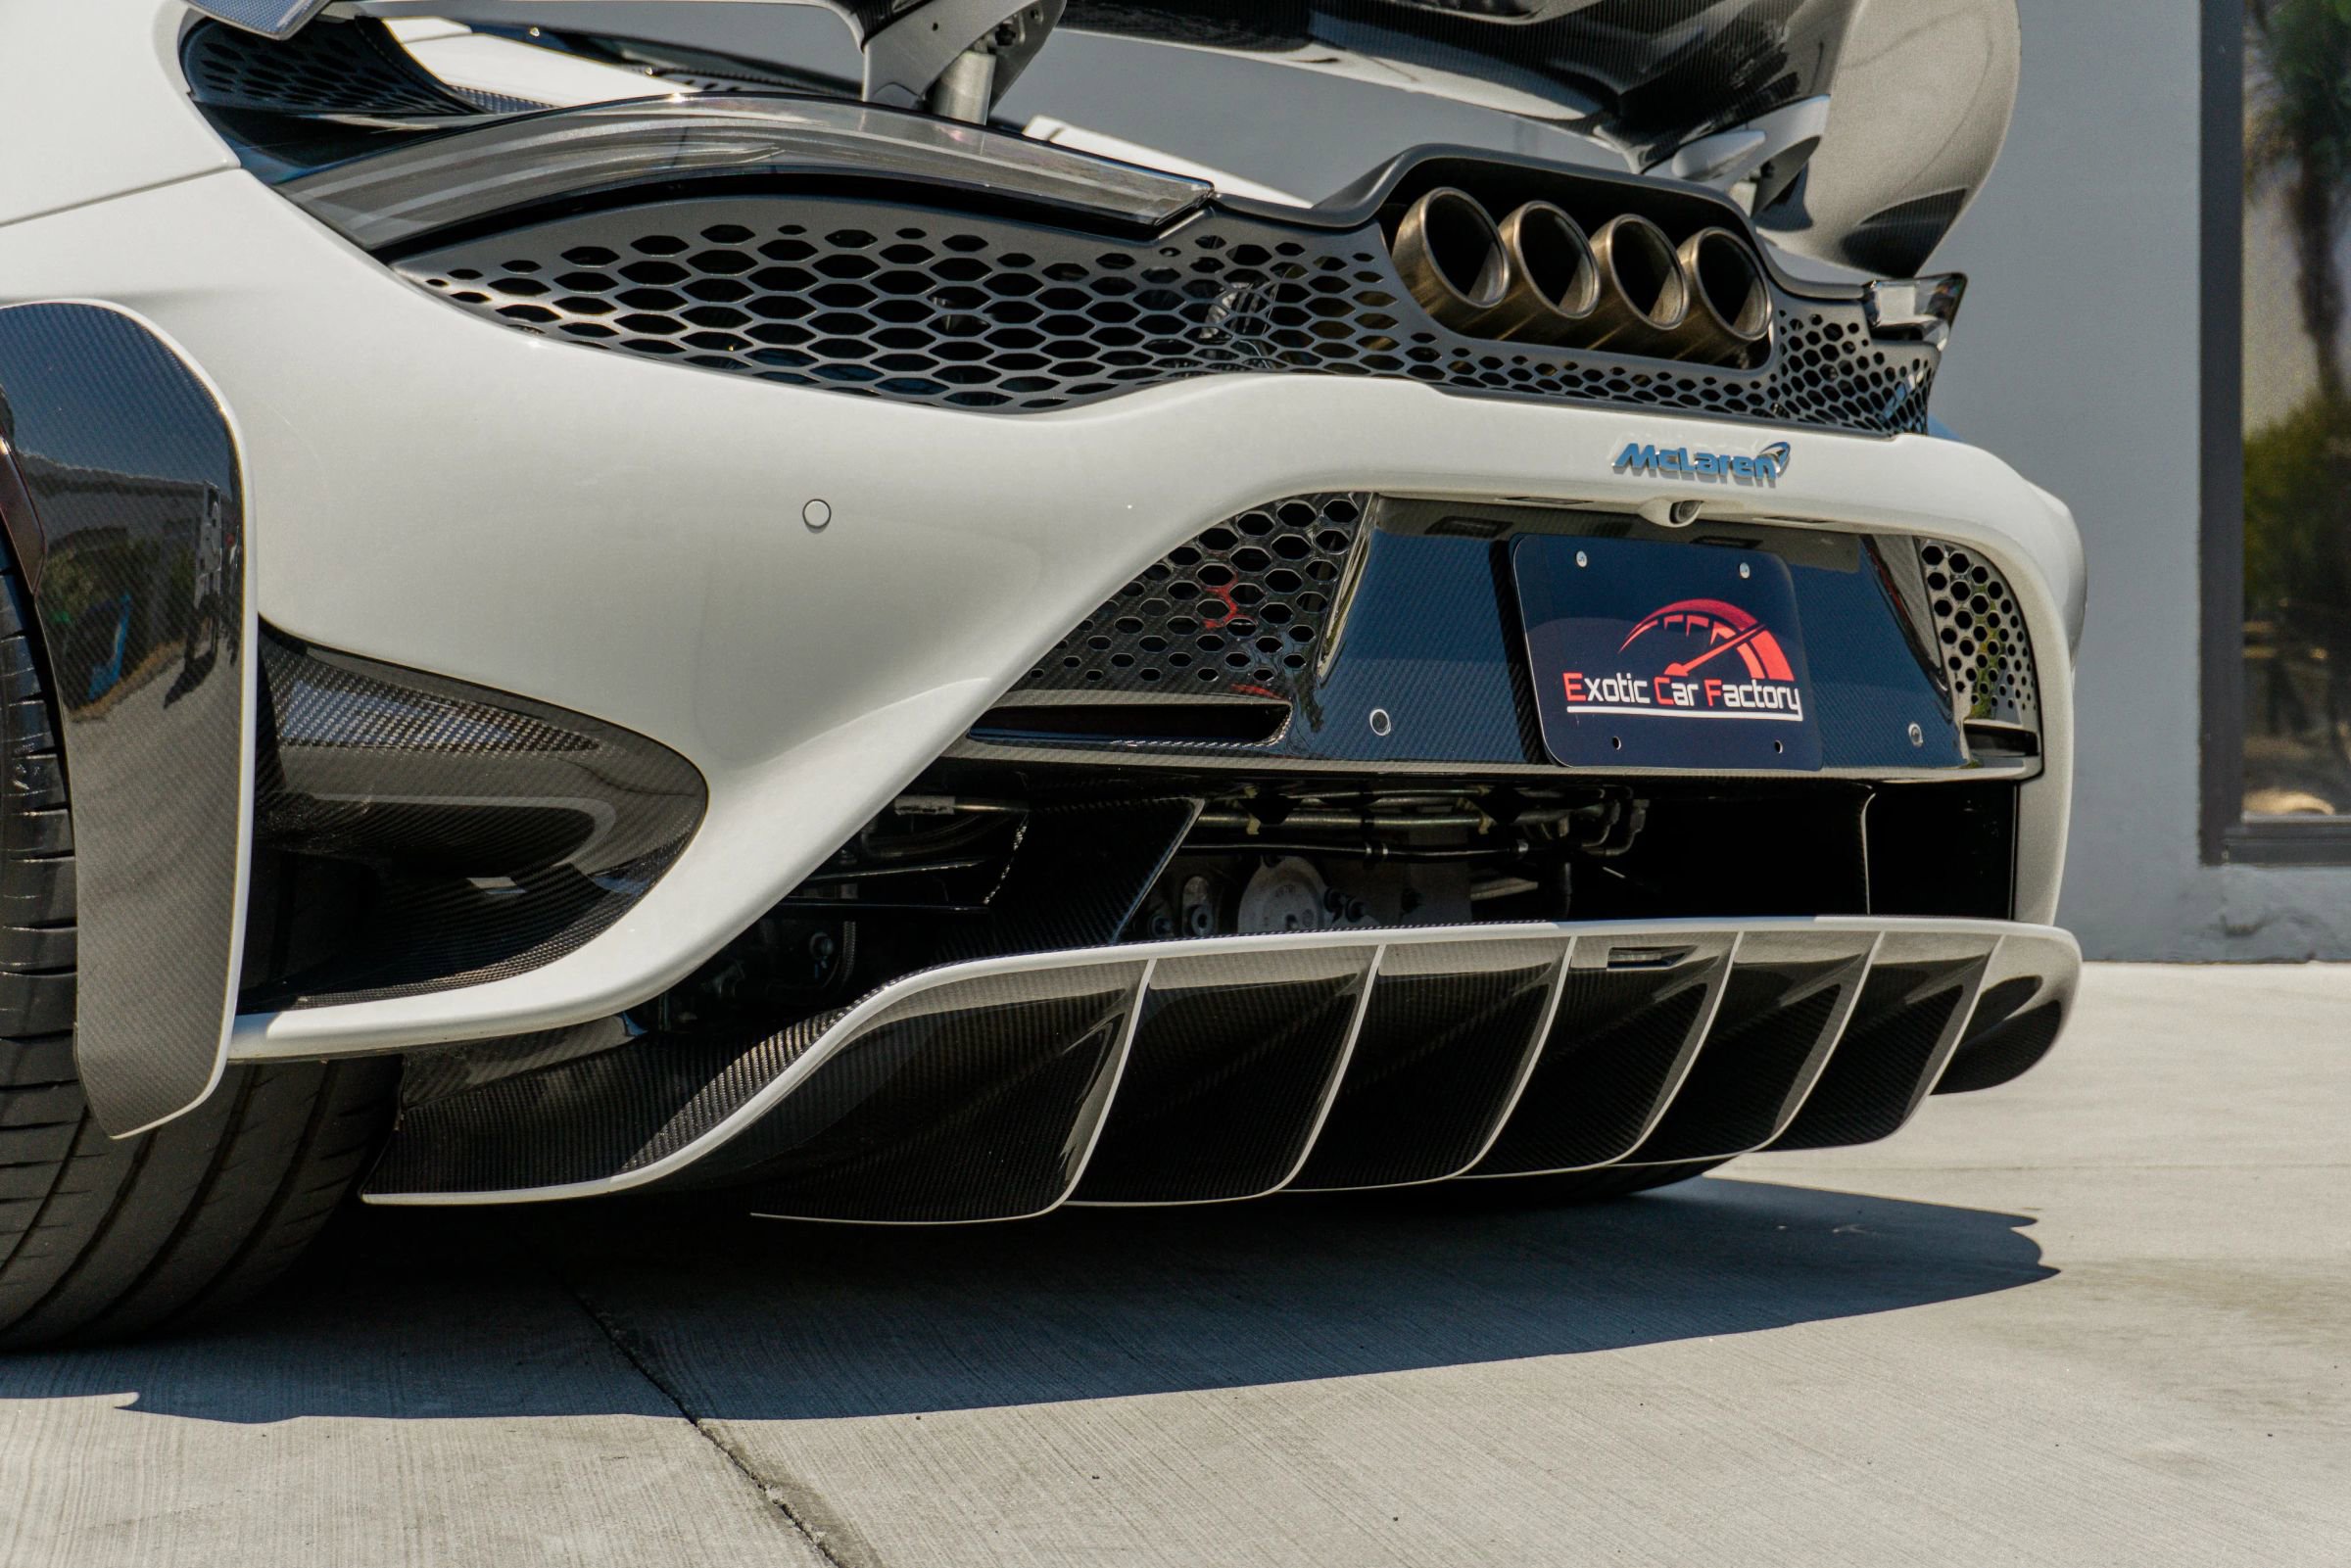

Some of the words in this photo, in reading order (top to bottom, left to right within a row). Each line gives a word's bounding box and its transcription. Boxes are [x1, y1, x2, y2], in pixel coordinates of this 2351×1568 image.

[1613, 442, 1782, 482] McLaren
[1562, 672, 1651, 704] Exotic
[1654, 677, 1699, 707] Car
[1703, 679, 1801, 711] Factory
